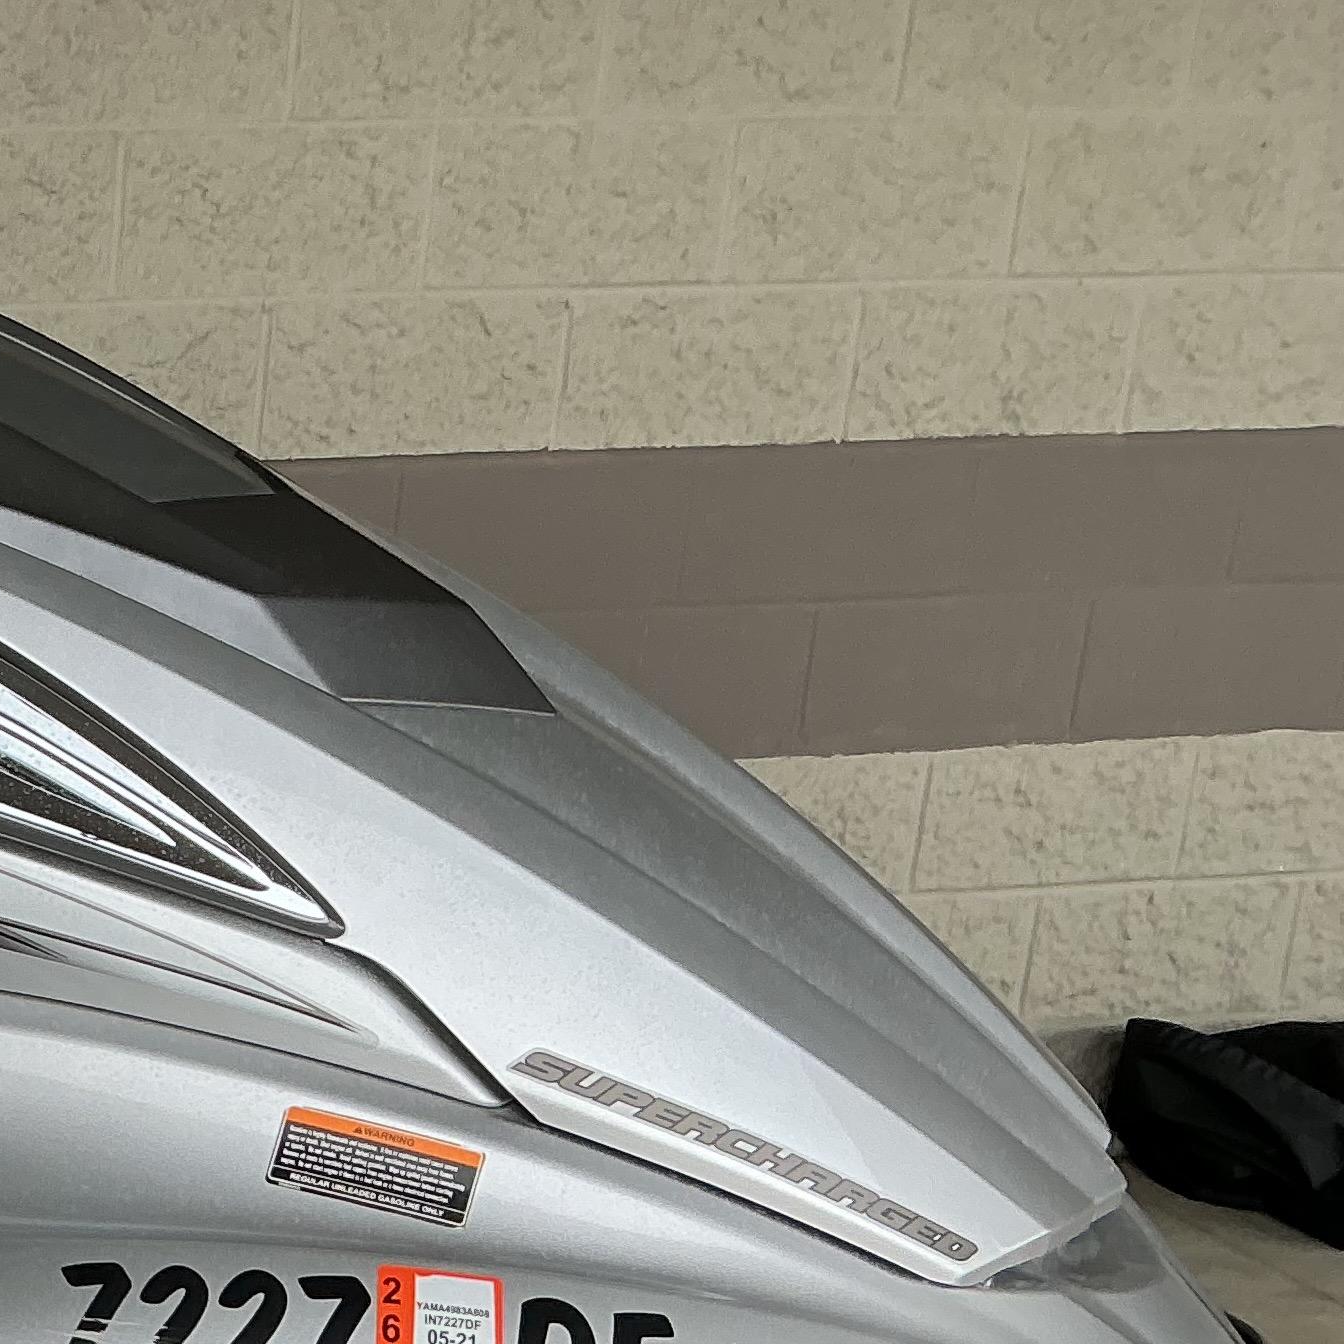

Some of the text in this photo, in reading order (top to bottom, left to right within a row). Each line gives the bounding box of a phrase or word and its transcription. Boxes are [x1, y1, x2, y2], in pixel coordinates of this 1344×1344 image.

[362, 1127, 416, 1148] WARNING
[511, 1051, 979, 1262] SUPERCHARGED
[289, 1172, 331, 1190] REGULAR
[331, 1181, 377, 1201] UNLEADED
[378, 1193, 421, 1211] GASOLINE
[422, 1204, 445, 1218] ONLY
[424, 1314, 482, 1331] IN7227DF
